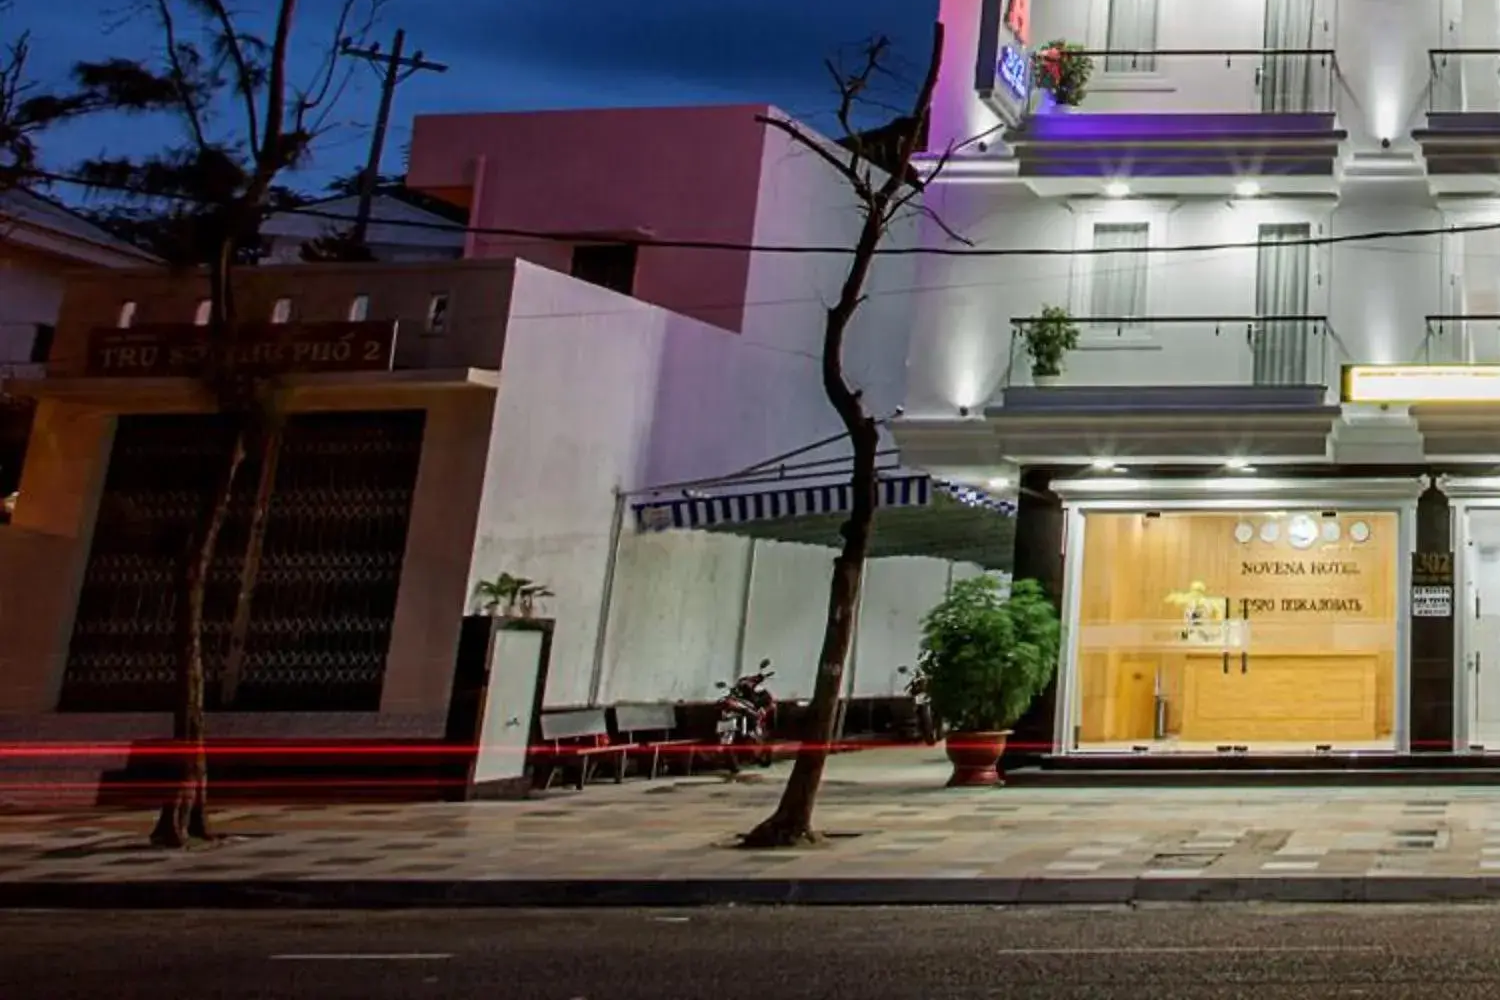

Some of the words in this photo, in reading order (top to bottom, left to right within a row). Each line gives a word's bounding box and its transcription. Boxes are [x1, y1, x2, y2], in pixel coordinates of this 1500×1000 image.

[362, 340, 382, 361] 2
[1241, 561, 1305, 576] NOVENA
[1310, 561, 1361, 575] HOTEL
